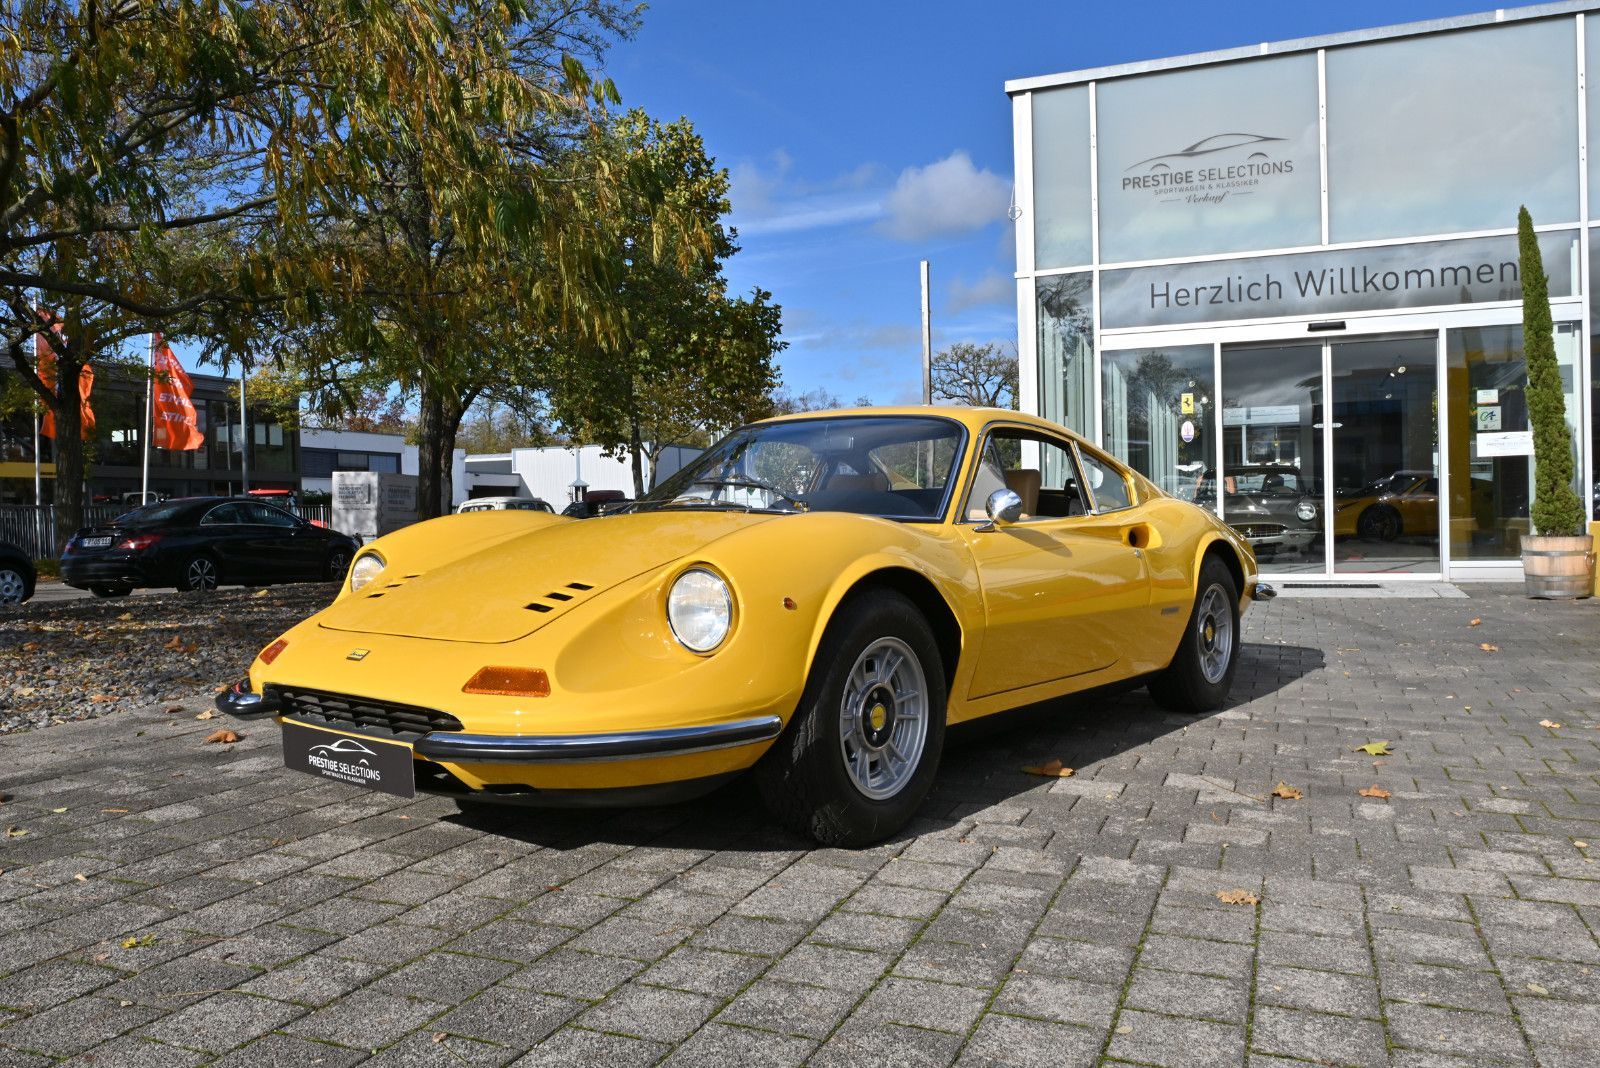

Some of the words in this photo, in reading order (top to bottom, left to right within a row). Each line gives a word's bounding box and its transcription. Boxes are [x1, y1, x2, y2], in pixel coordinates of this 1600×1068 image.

[1122, 170, 1194, 191] PRESTIGE
[1198, 160, 1294, 182] SELECTIONS
[1154, 184, 1206, 196] SPORTWAGEN
[1216, 179, 1260, 189] KLASSIKER
[1185, 191, 1229, 204] Verkauf
[1150, 273, 1283, 309] Herzlich
[1294, 260, 1518, 298] Willkommen
[308, 754, 338, 772] PRESTIGE
[338, 762, 381, 781] SELECTIONS
[321, 769, 343, 779] SPORTWAGEN
